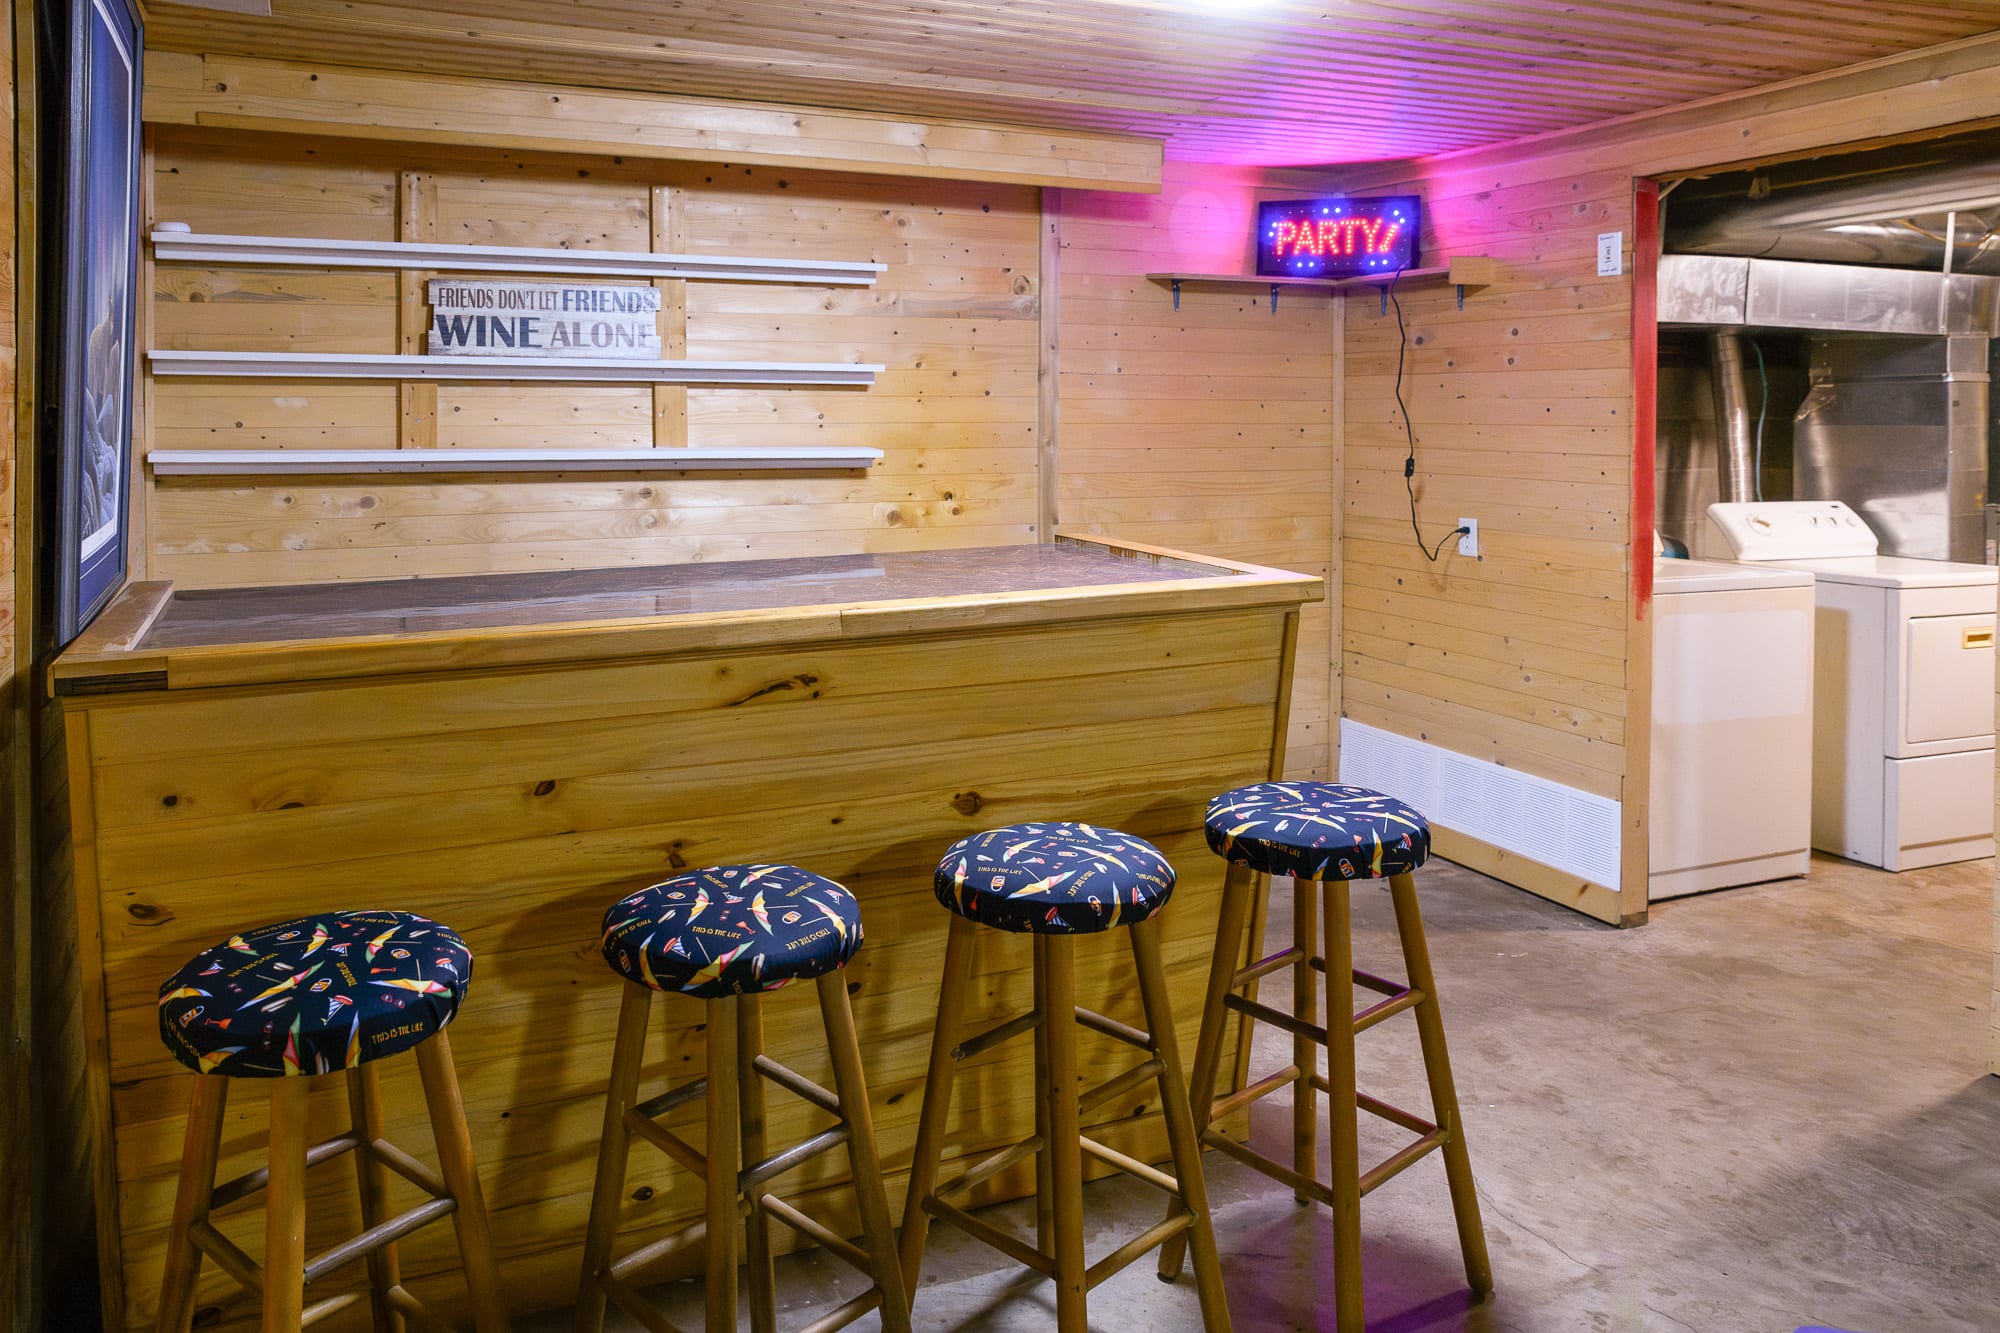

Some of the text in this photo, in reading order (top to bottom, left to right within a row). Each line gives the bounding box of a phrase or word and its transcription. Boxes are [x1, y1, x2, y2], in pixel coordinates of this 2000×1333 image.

[438, 287, 656, 313] FRIENDS DON'T LET FRIENDS
[435, 314, 656, 348] WINE ALONE
[692, 925, 706, 933] THIS
[371, 1031, 390, 1045] THIS
[398, 1024, 411, 1036] THE
